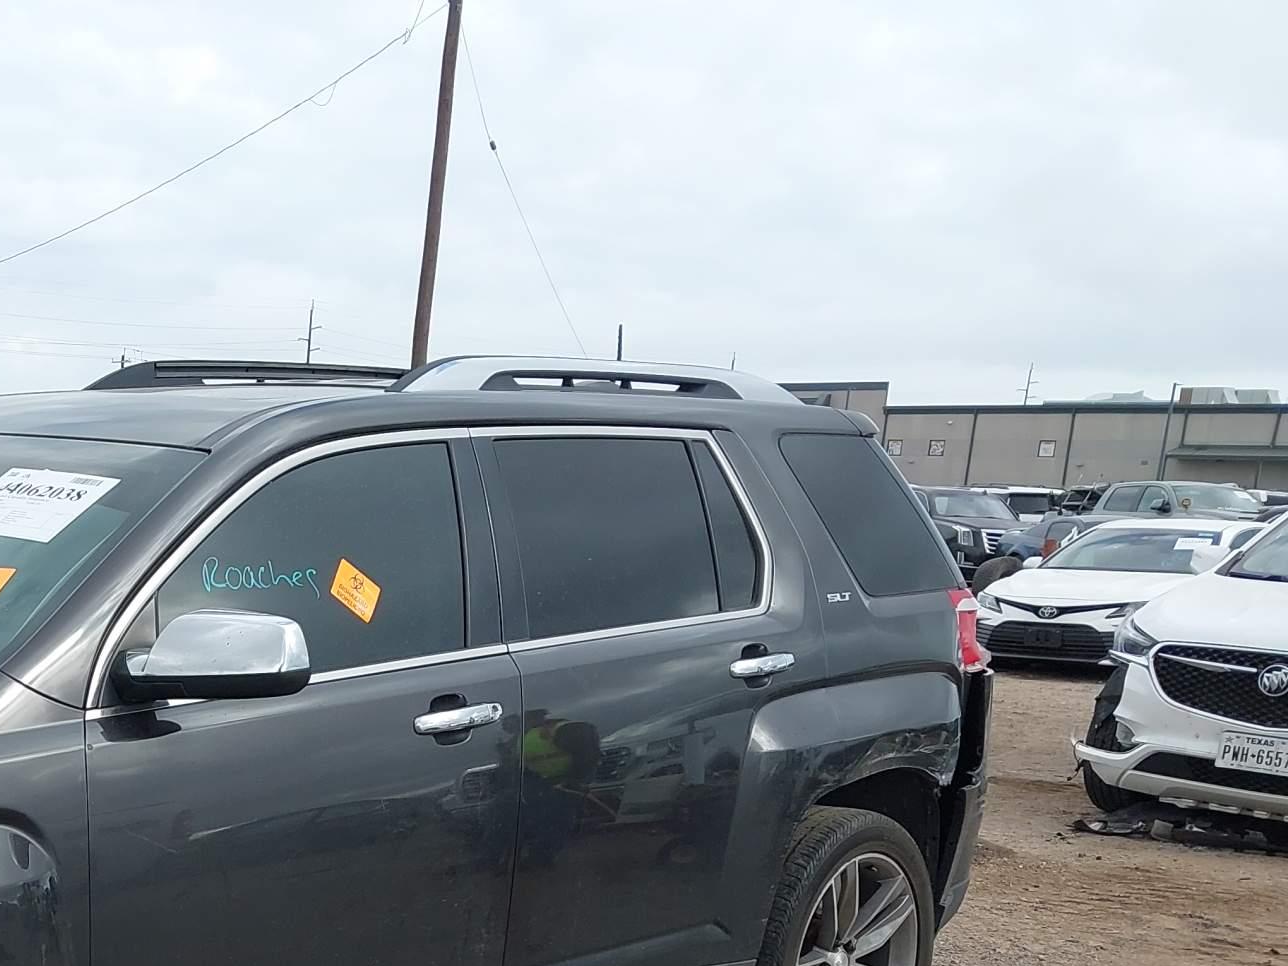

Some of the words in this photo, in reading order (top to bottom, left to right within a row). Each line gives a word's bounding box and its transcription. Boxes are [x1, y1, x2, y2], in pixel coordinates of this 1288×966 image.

[202, 556, 320, 599] Roaches
[827, 591, 852, 603] SLT
[1246, 737, 1275, 747] TEXAS
